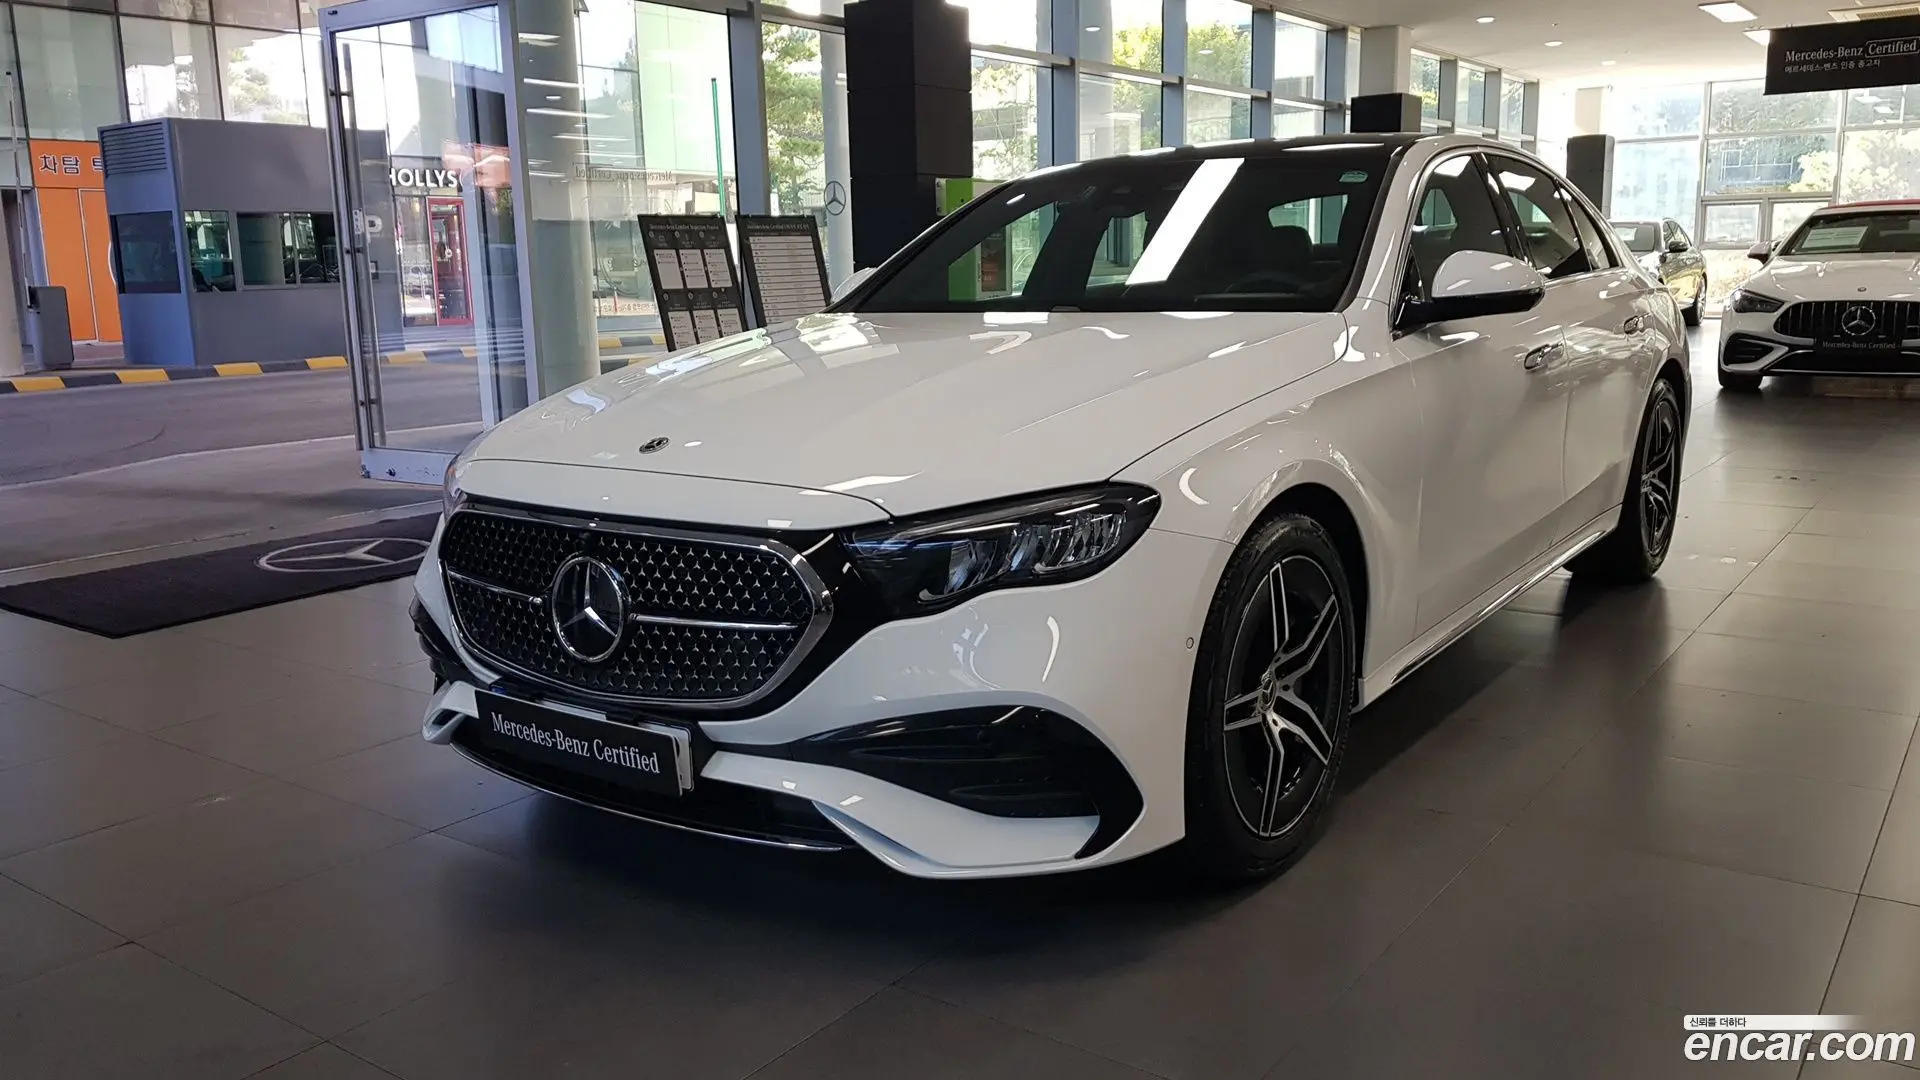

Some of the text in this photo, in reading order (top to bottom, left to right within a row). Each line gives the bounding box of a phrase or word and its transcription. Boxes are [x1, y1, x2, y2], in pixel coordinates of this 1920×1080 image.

[1785, 39, 1917, 62] Mercedes-Benz Certified
[491, 711, 660, 774] Mercedes-Benz Certified
